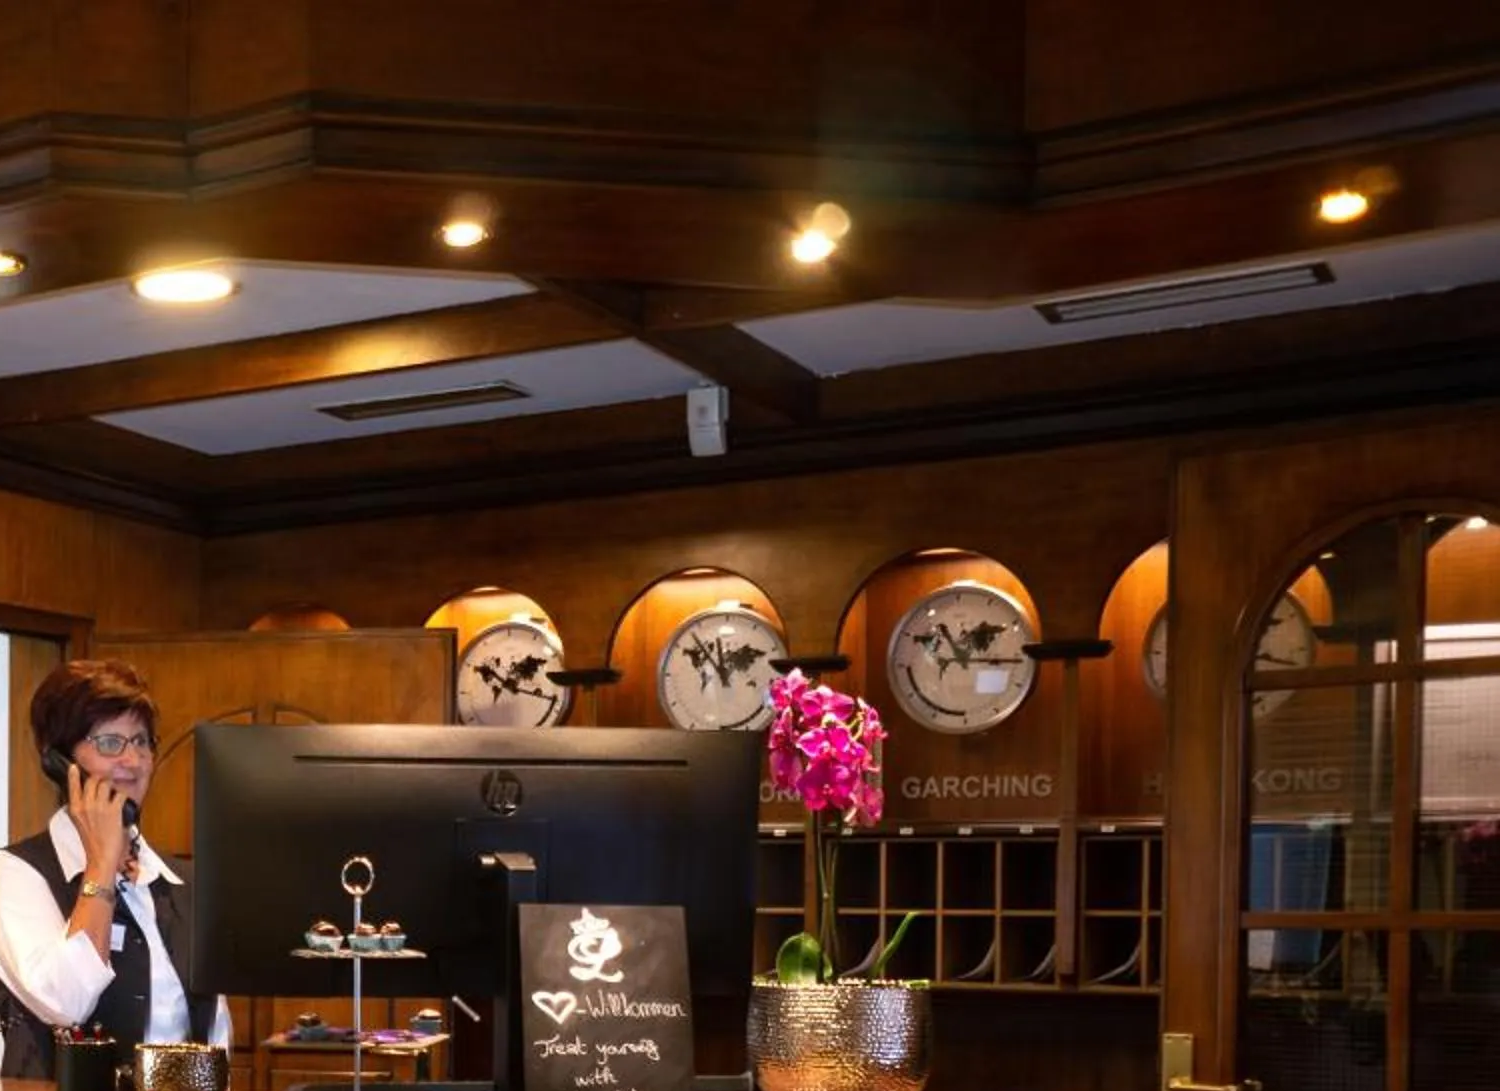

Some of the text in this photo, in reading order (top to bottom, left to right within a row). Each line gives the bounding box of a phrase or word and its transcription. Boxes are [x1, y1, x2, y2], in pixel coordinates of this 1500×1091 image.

[900, 773, 1053, 799] GARCHING
[533, 1034, 588, 1058] Treat
[574, 1066, 619, 1087] with
